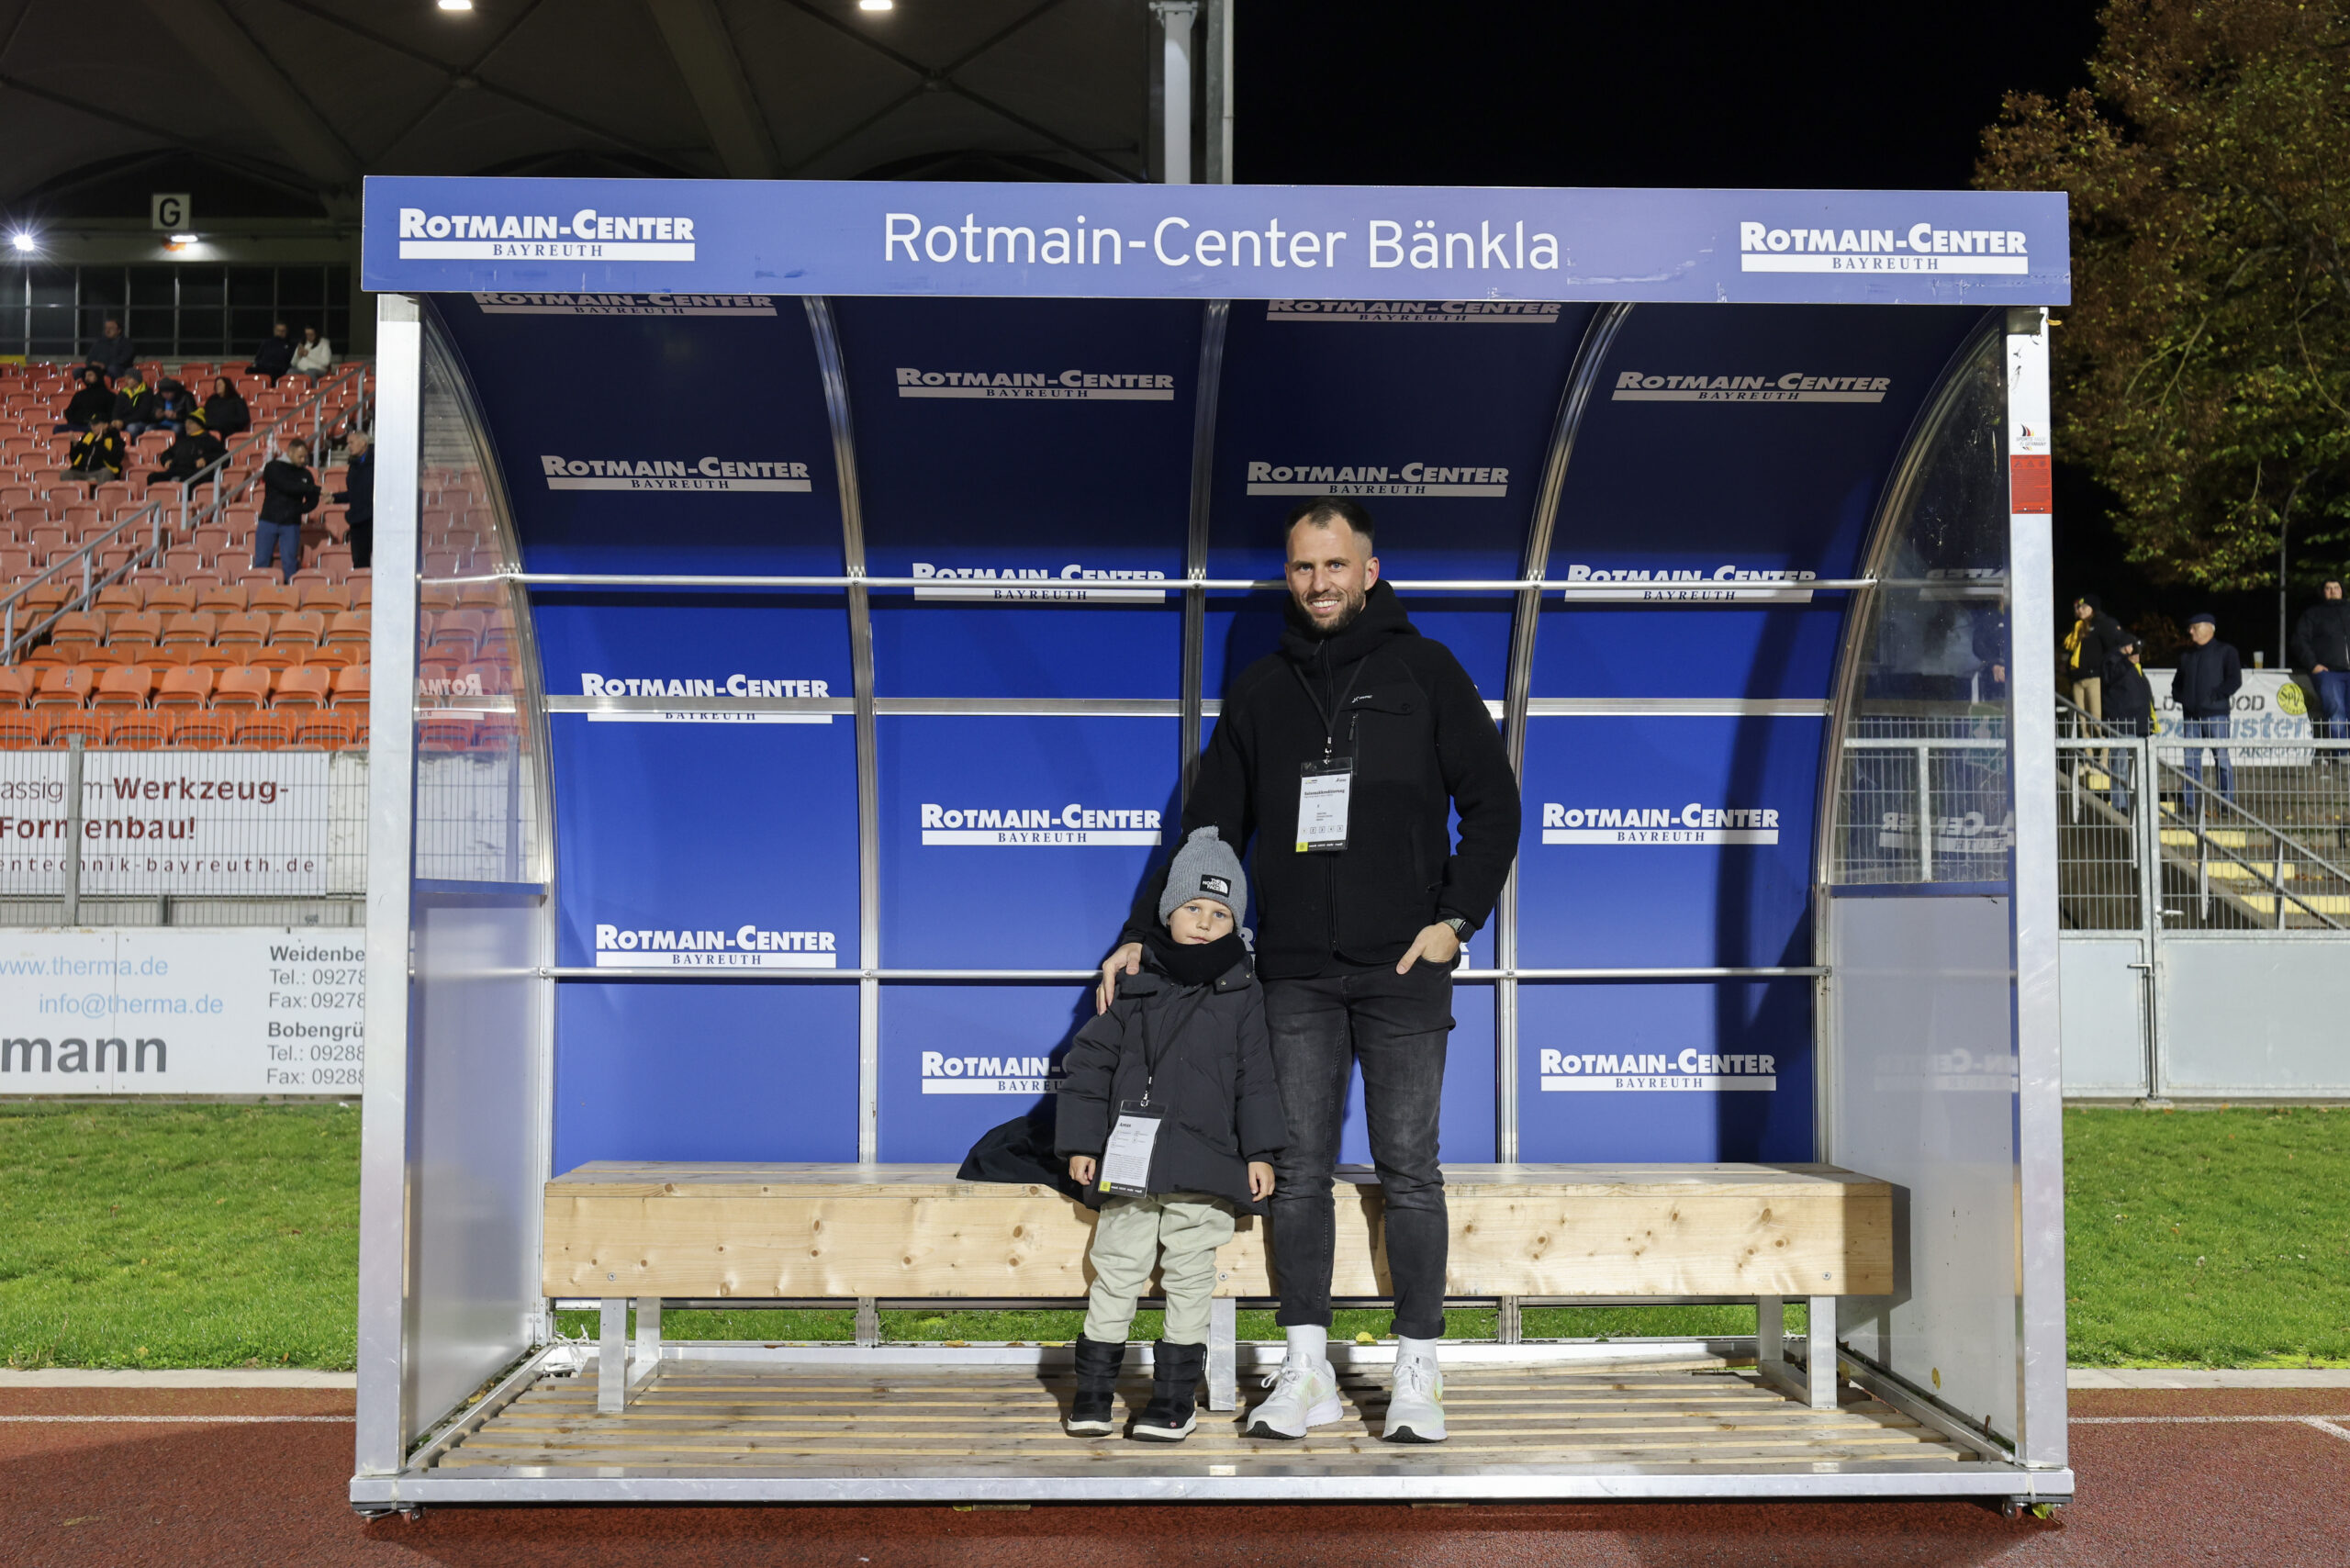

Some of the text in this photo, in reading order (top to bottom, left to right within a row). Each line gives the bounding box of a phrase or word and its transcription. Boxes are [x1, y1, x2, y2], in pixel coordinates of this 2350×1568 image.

[159, 197, 181, 228] G
[399, 208, 695, 241] ROTMAIN-CENTER
[884, 213, 1559, 270] Rotmain-Center Bänkla
[1740, 221, 2028, 253] ROTMAIN-CENTER
[493, 243, 603, 257] BAYREUTH
[1832, 257, 1939, 271] BAYREUTH
[471, 292, 775, 308] ROTMAIN-CENTER
[1268, 299, 1561, 314] ROTMAIN-CENTER
[575, 307, 687, 315] BAYREUTH
[1359, 313, 1468, 321] BAYREUTH
[896, 367, 1174, 388] ROTMAIN-CENTER
[1614, 371, 1891, 392] ROTMAIN-CENTER
[986, 388, 1089, 398] BAYREUTH
[1698, 391, 1800, 401] BAYREUTH
[541, 455, 810, 478] ROTMAIN-CENTER
[1248, 462, 1509, 484] ROTMAIN-CENTER
[632, 478, 730, 489] BAYREUTH
[1329, 484, 1426, 495] BAYREUTH
[994, 589, 1088, 600] BAYREUTH
[1643, 590, 1737, 600] BAYREUTH
[581, 673, 830, 698] ROTMAIN-CENTER
[113, 777, 288, 803] Werkzeug-
[921, 803, 1161, 829] ROTMAIN-CENTER
[1543, 802, 1779, 828] ROTMAIN-CENTER
[998, 832, 1088, 844] BAYREUTH
[1617, 832, 1705, 842] BAYREUTH
[596, 924, 836, 952] ROTMAIN-CENTER
[270, 946, 365, 962] Weidenbe
[672, 954, 762, 966] BAYREUTH
[0, 956, 169, 976] www.therma.de
[269, 969, 364, 985] Tel.: 09278
[39, 992, 224, 1019] info@therma.de
[269, 992, 364, 1008] Fax: 09278
[268, 1022, 364, 1042] Bobengrü
[1, 1037, 167, 1073] mann
[267, 1045, 304, 1061] Tel.:
[1540, 1048, 1775, 1074] ROTMAIN-CENTER
[266, 1068, 306, 1084] Fax:
[1616, 1077, 1703, 1088] BAYREUTH
